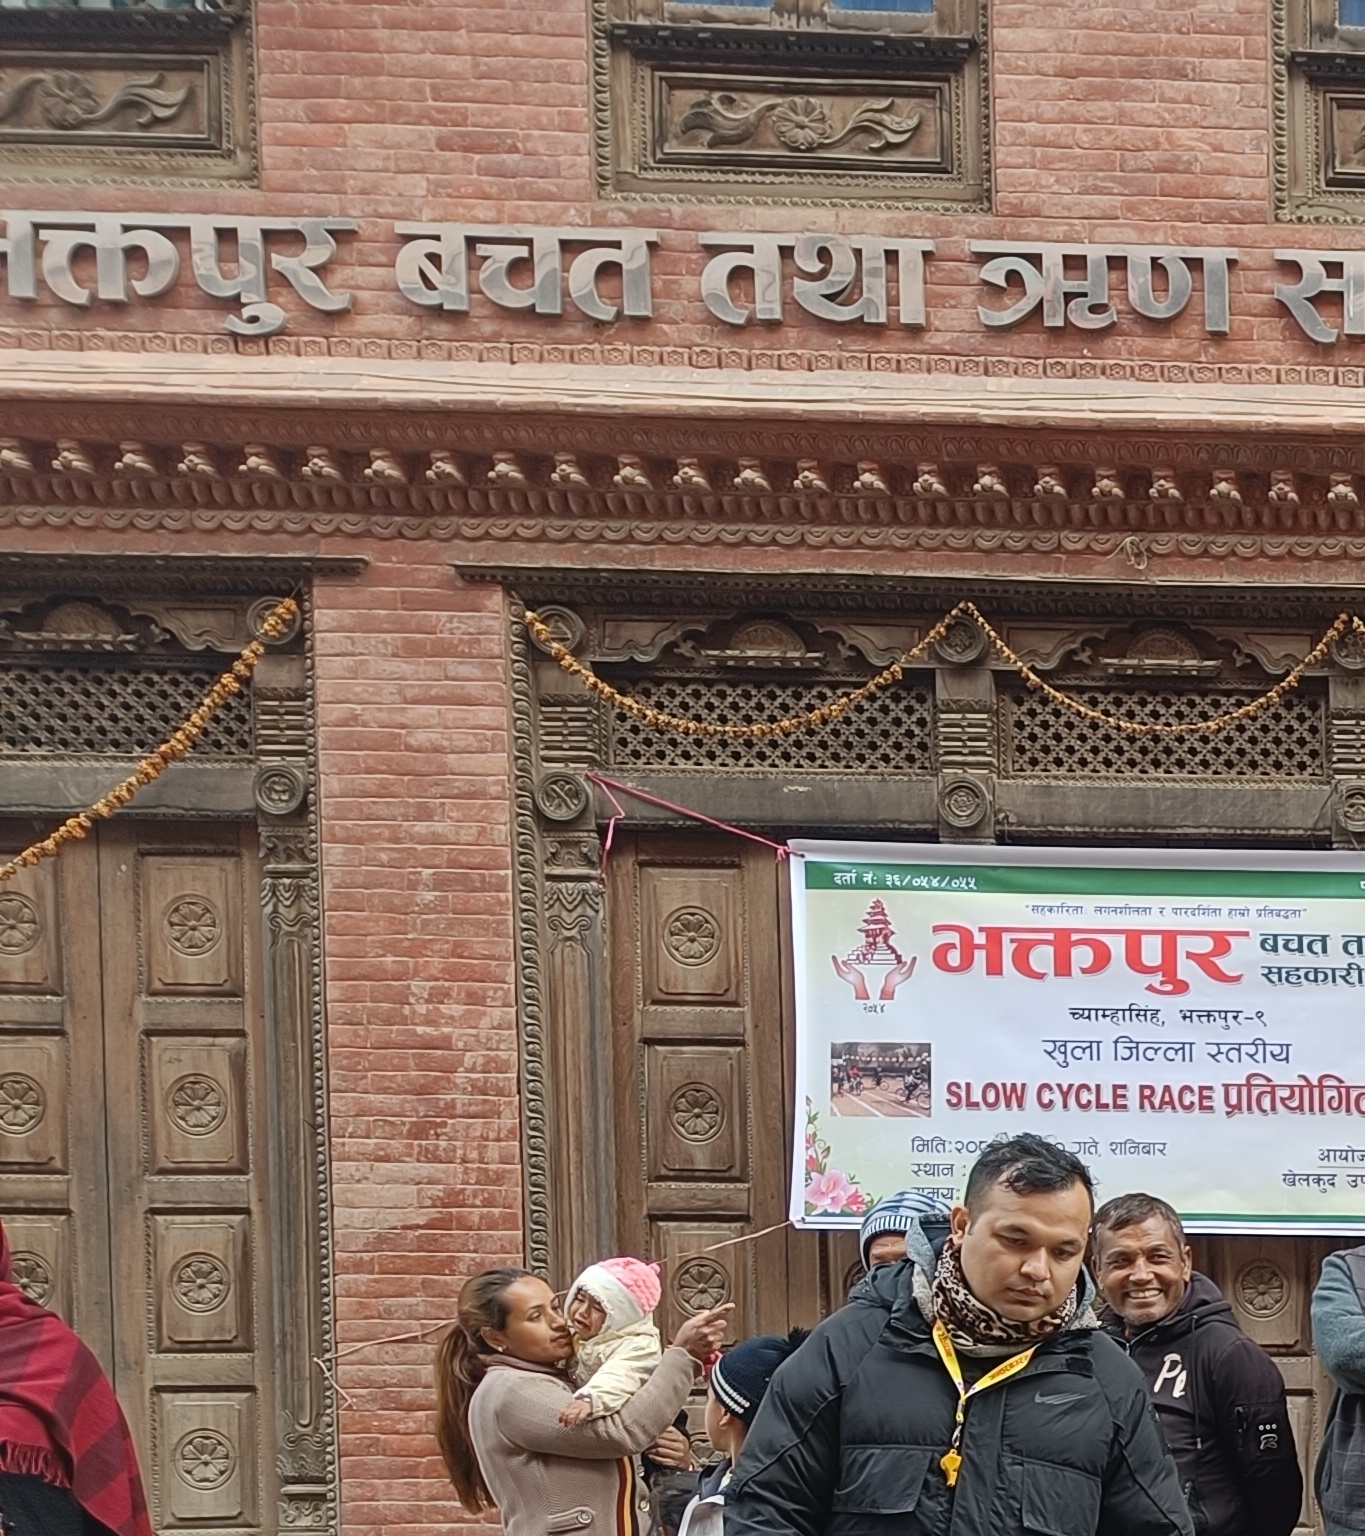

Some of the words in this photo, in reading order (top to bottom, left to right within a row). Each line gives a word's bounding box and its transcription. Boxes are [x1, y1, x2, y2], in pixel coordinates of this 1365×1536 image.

[394, 220, 660, 321] बचत
[698, 231, 936, 328] तथा
[968, 239, 1240, 336] ऋण
[833, 869, 857, 885] दर्ता
[1094, 905, 1151, 917] लगनशीलता
[1158, 906, 1166, 917] र
[1171, 904, 1222, 919] पारदर्शिता
[1228, 905, 1250, 919] हाम्रो
[931, 923, 1251, 997] भक्तपुर
[1259, 932, 1331, 956] बचत
[1261, 962, 1365, 986] सहकारी
[1042, 1038, 1102, 1068] खुला
[1113, 1035, 1196, 1065] जिल्ला
[1205, 1038, 1292, 1065] स्तरीय
[945, 1081, 1027, 1111] SLOW
[1036, 1082, 1128, 1112] CYCLE
[1137, 1084, 1214, 1113] RACE
[1109, 1138, 1168, 1157] शनिबार
[1282, 1169, 1337, 1193] खेलकुद
